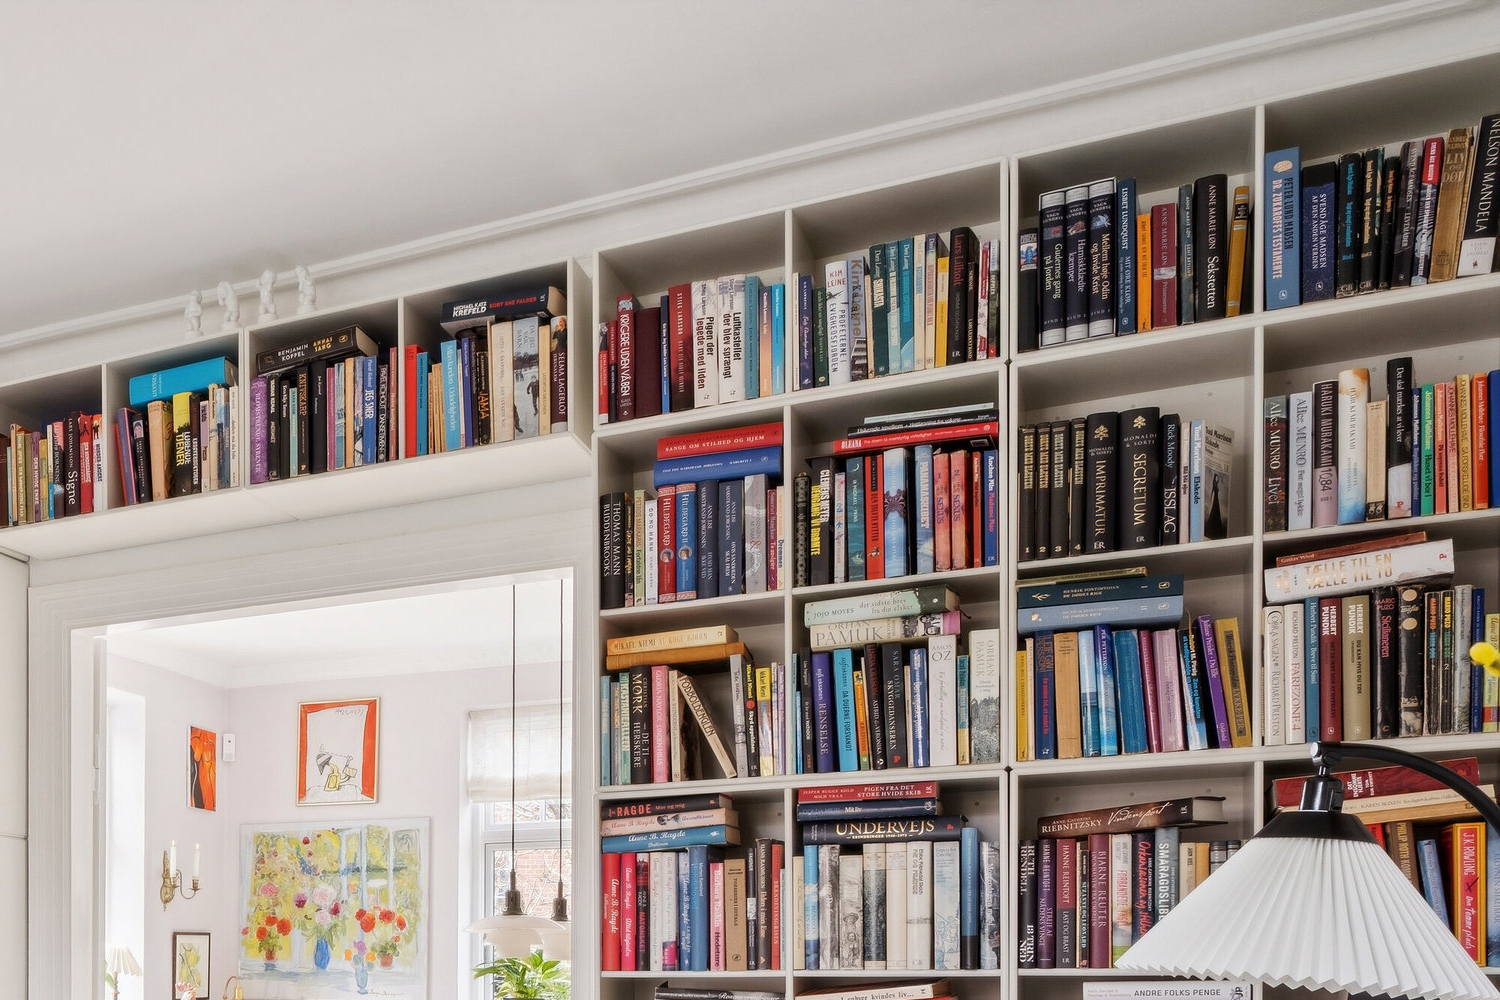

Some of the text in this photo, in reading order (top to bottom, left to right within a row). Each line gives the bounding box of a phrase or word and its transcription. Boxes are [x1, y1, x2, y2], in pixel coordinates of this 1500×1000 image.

[1270, 401, 1280, 428] Alice
[1296, 398, 1307, 424] Alice
[1320, 383, 1333, 416] HARUKI
[1269, 429, 1281, 470] MUNRO
[1295, 426, 1307, 467] MUNRO
[1320, 419, 1333, 467] MURAKAMI
[65, 470, 78, 506] Signe
[1095, 460, 1106, 537] IMPRIMATUR
[1133, 452, 1147, 527] SECRETUM
[612, 501, 621, 577] THOMAS MANN
[815, 626, 884, 646] PAMUK
[1134, 988, 1221, 997] ANDRE FOLKS PENGE
